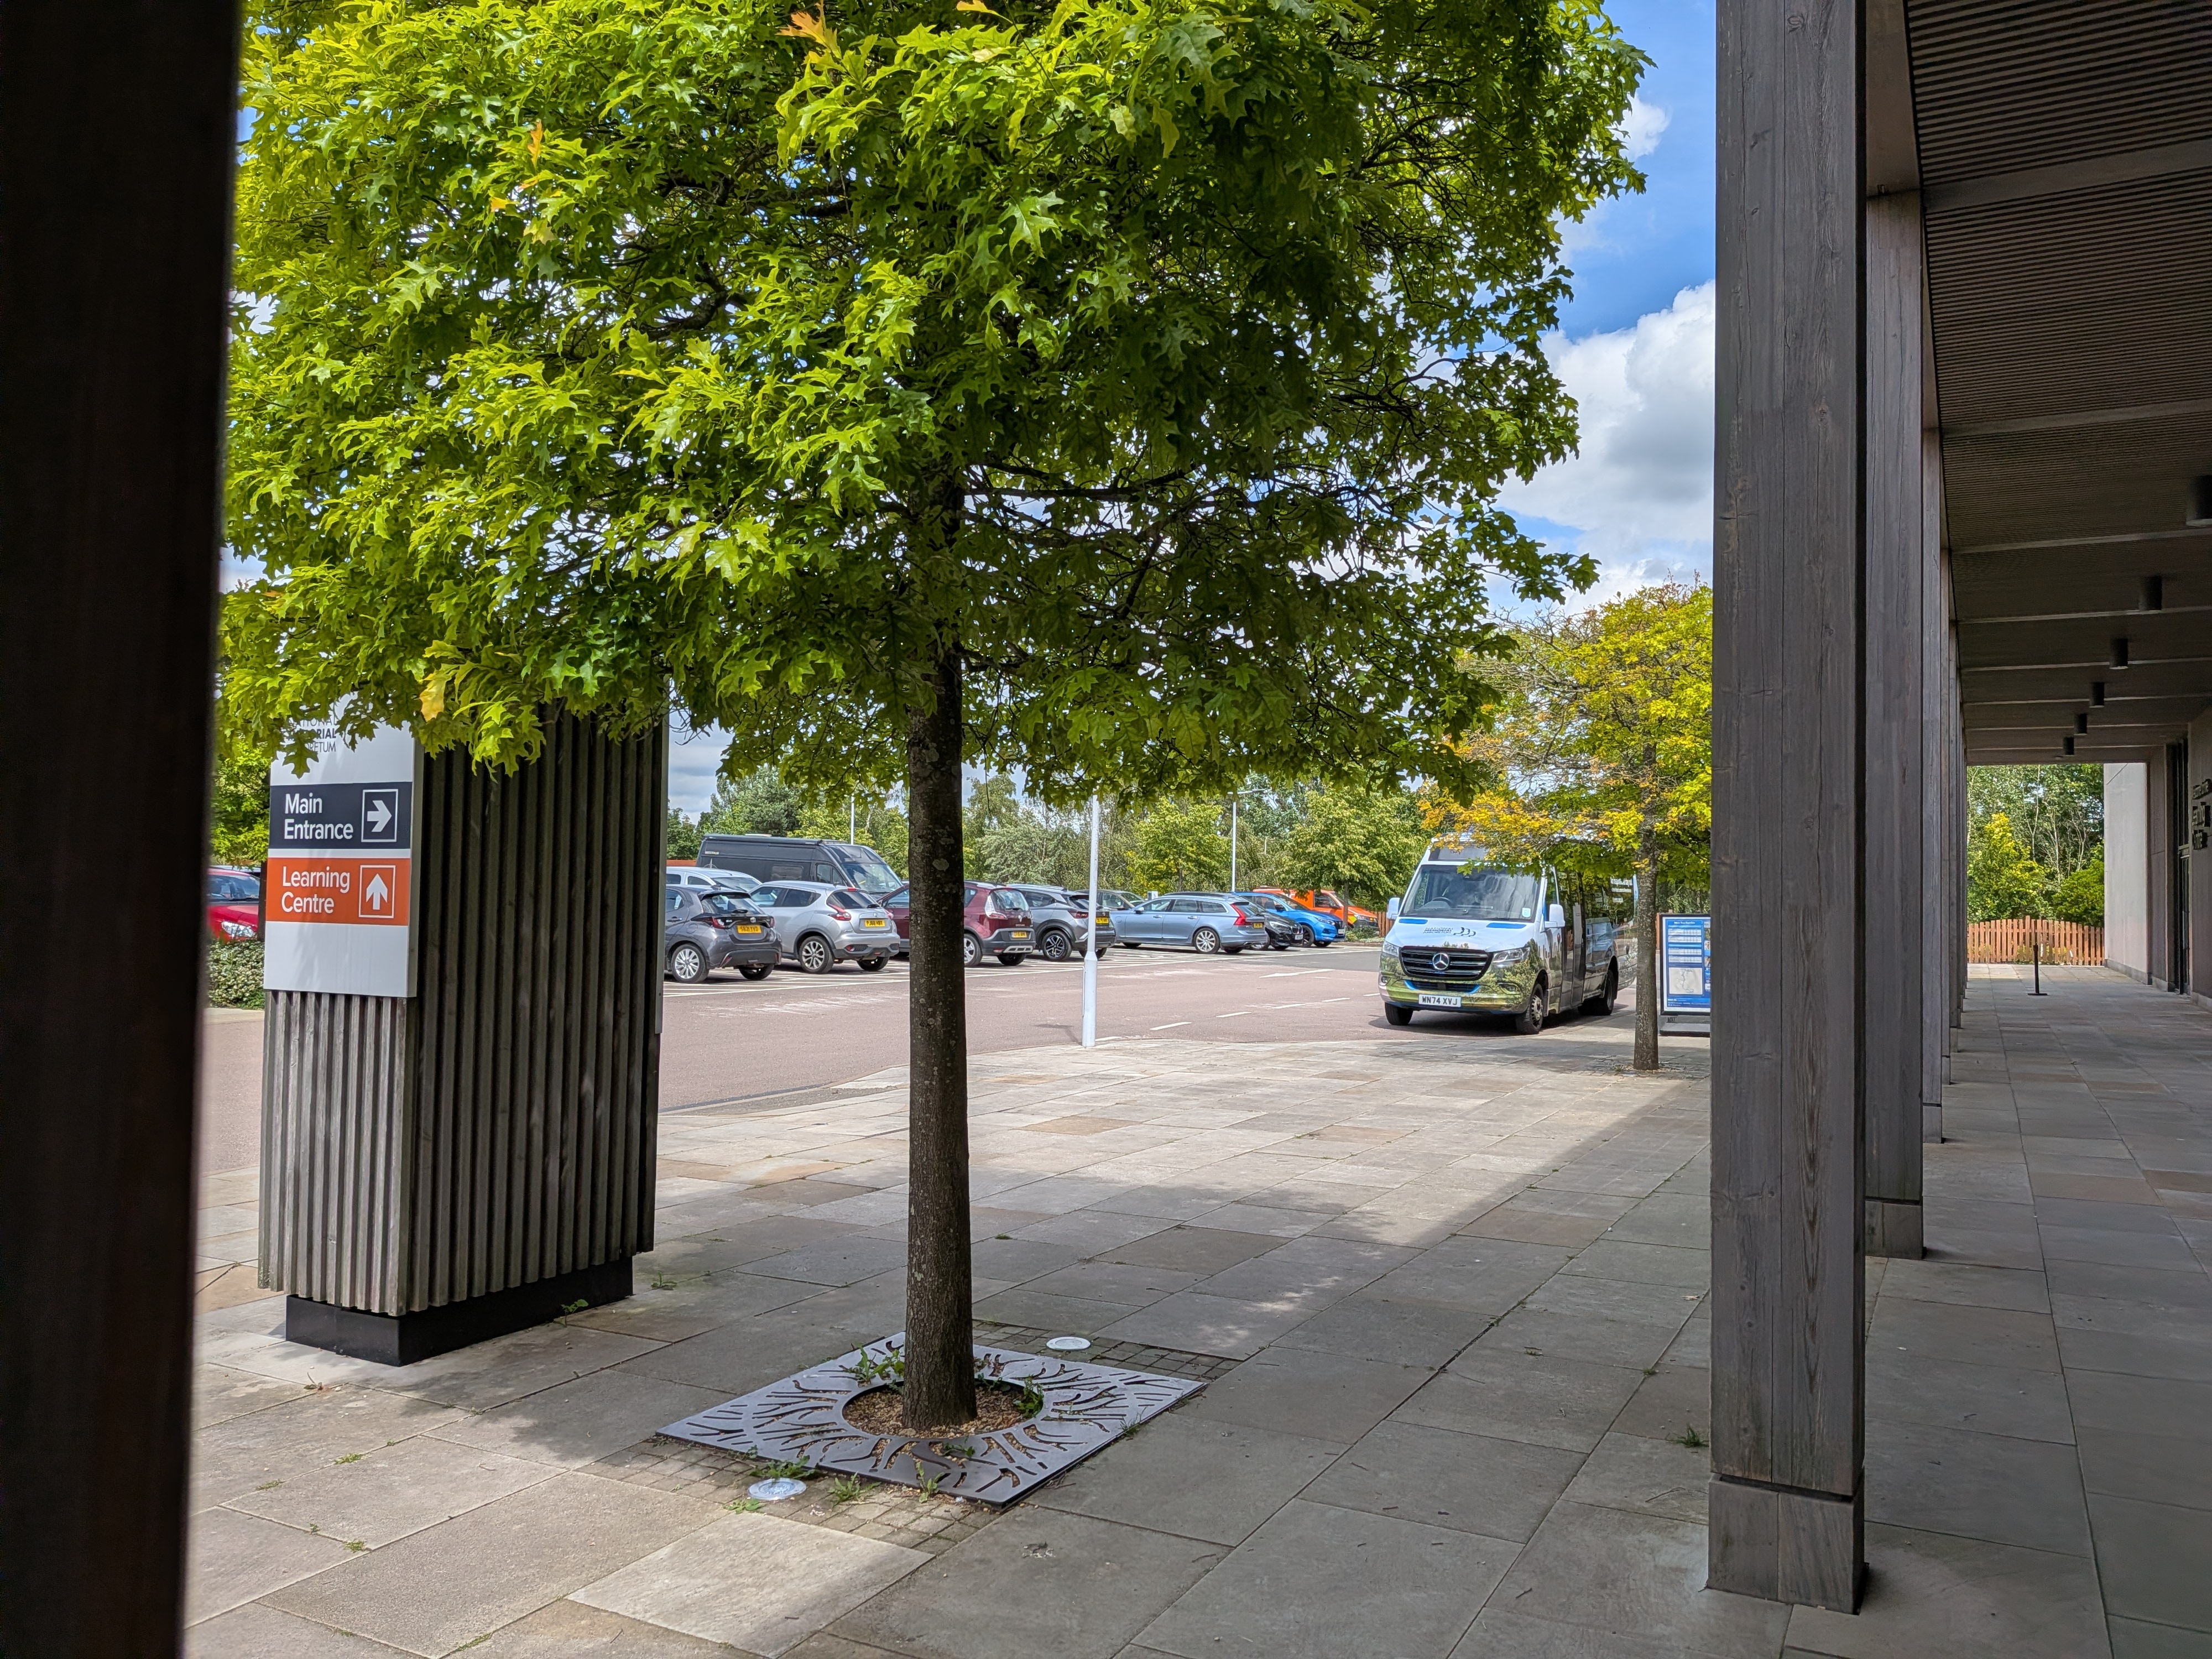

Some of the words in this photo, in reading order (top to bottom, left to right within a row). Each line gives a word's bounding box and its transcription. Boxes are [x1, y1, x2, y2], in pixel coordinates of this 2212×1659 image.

[285, 792, 322, 814] Main
[284, 819, 353, 840] Entrance
[282, 866, 350, 894] Learning
[281, 891, 335, 914] Centre
[1422, 996, 1441, 1004] WN74
